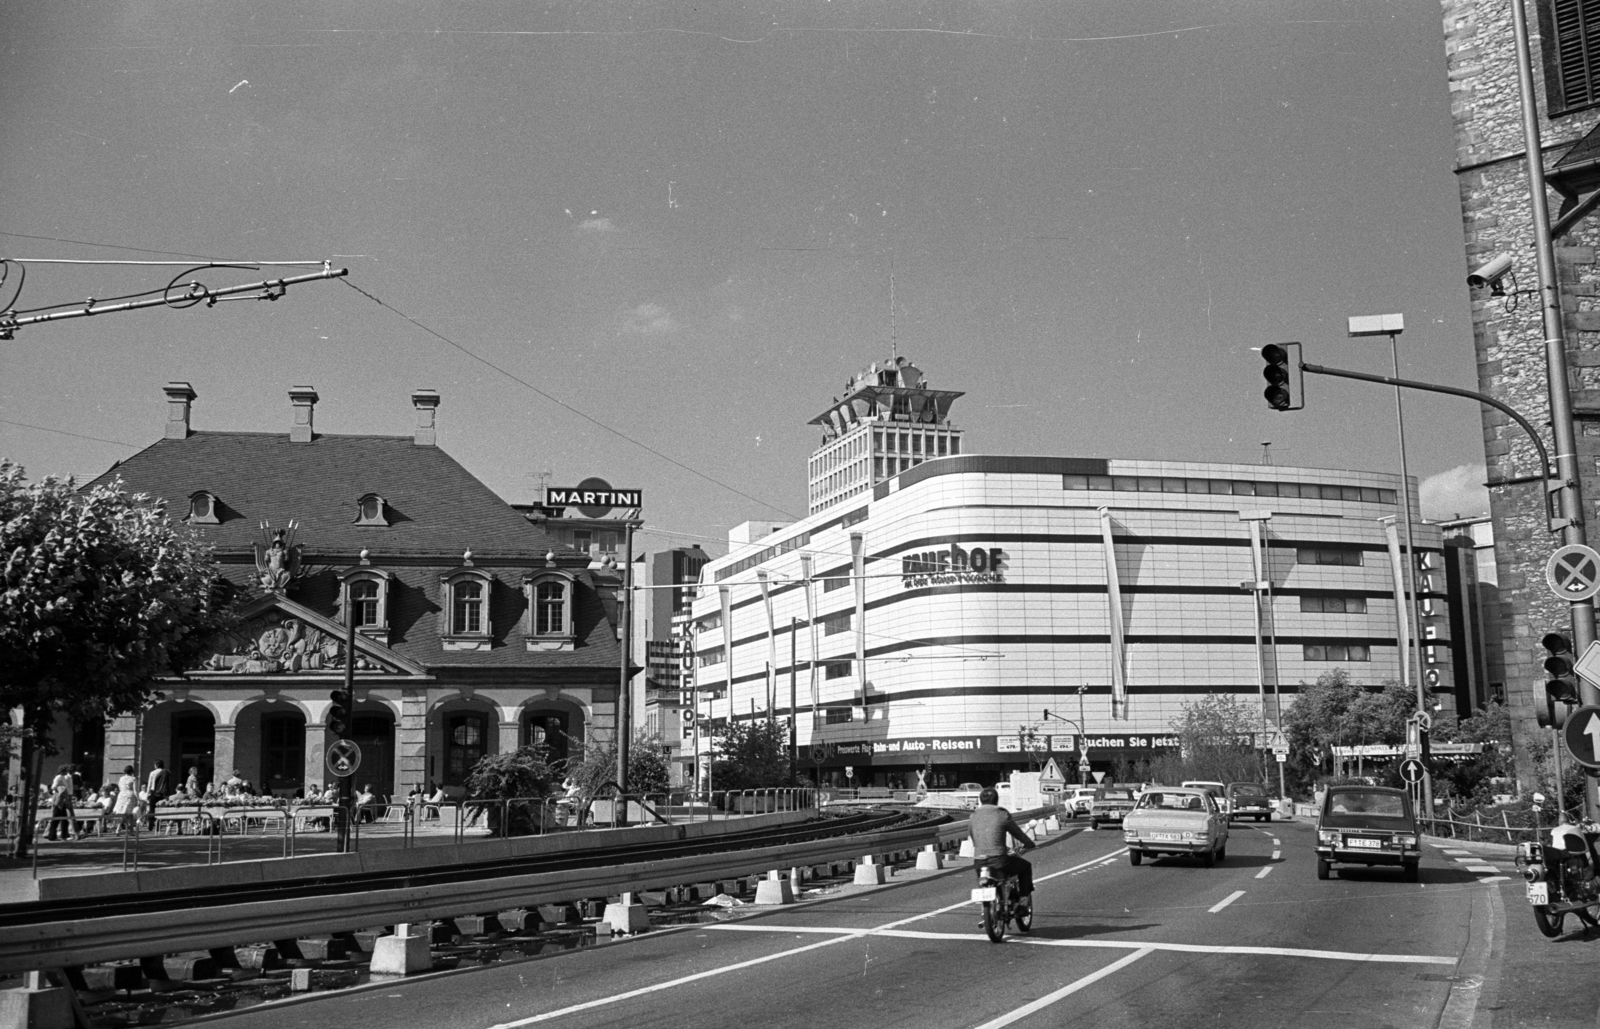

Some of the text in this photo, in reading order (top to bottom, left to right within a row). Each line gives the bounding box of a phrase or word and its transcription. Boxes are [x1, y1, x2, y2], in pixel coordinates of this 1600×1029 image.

[550, 491, 638, 505] MARTINI
[682, 621, 694, 739] KAUFHOF
[1129, 737, 1147, 747] Sie
[1151, 736, 1179, 748] jetzt
[1528, 884, 1535, 893] F
